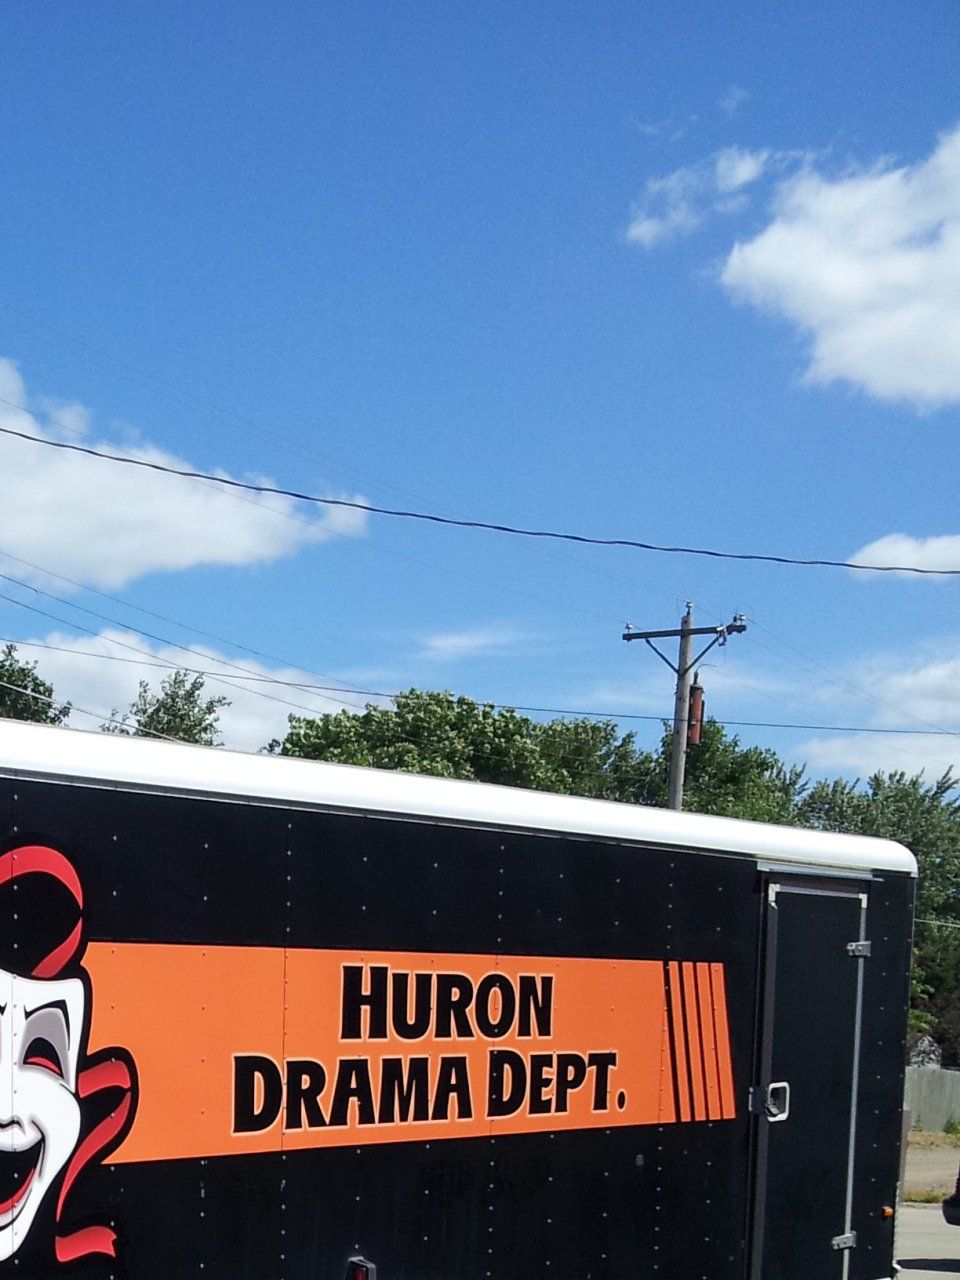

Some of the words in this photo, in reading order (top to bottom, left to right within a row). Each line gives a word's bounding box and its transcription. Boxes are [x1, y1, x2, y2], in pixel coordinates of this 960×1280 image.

[340, 964, 554, 1041] HURON
[232, 1053, 474, 1136] DRAMA
[486, 1049, 627, 1119] DEPT.
